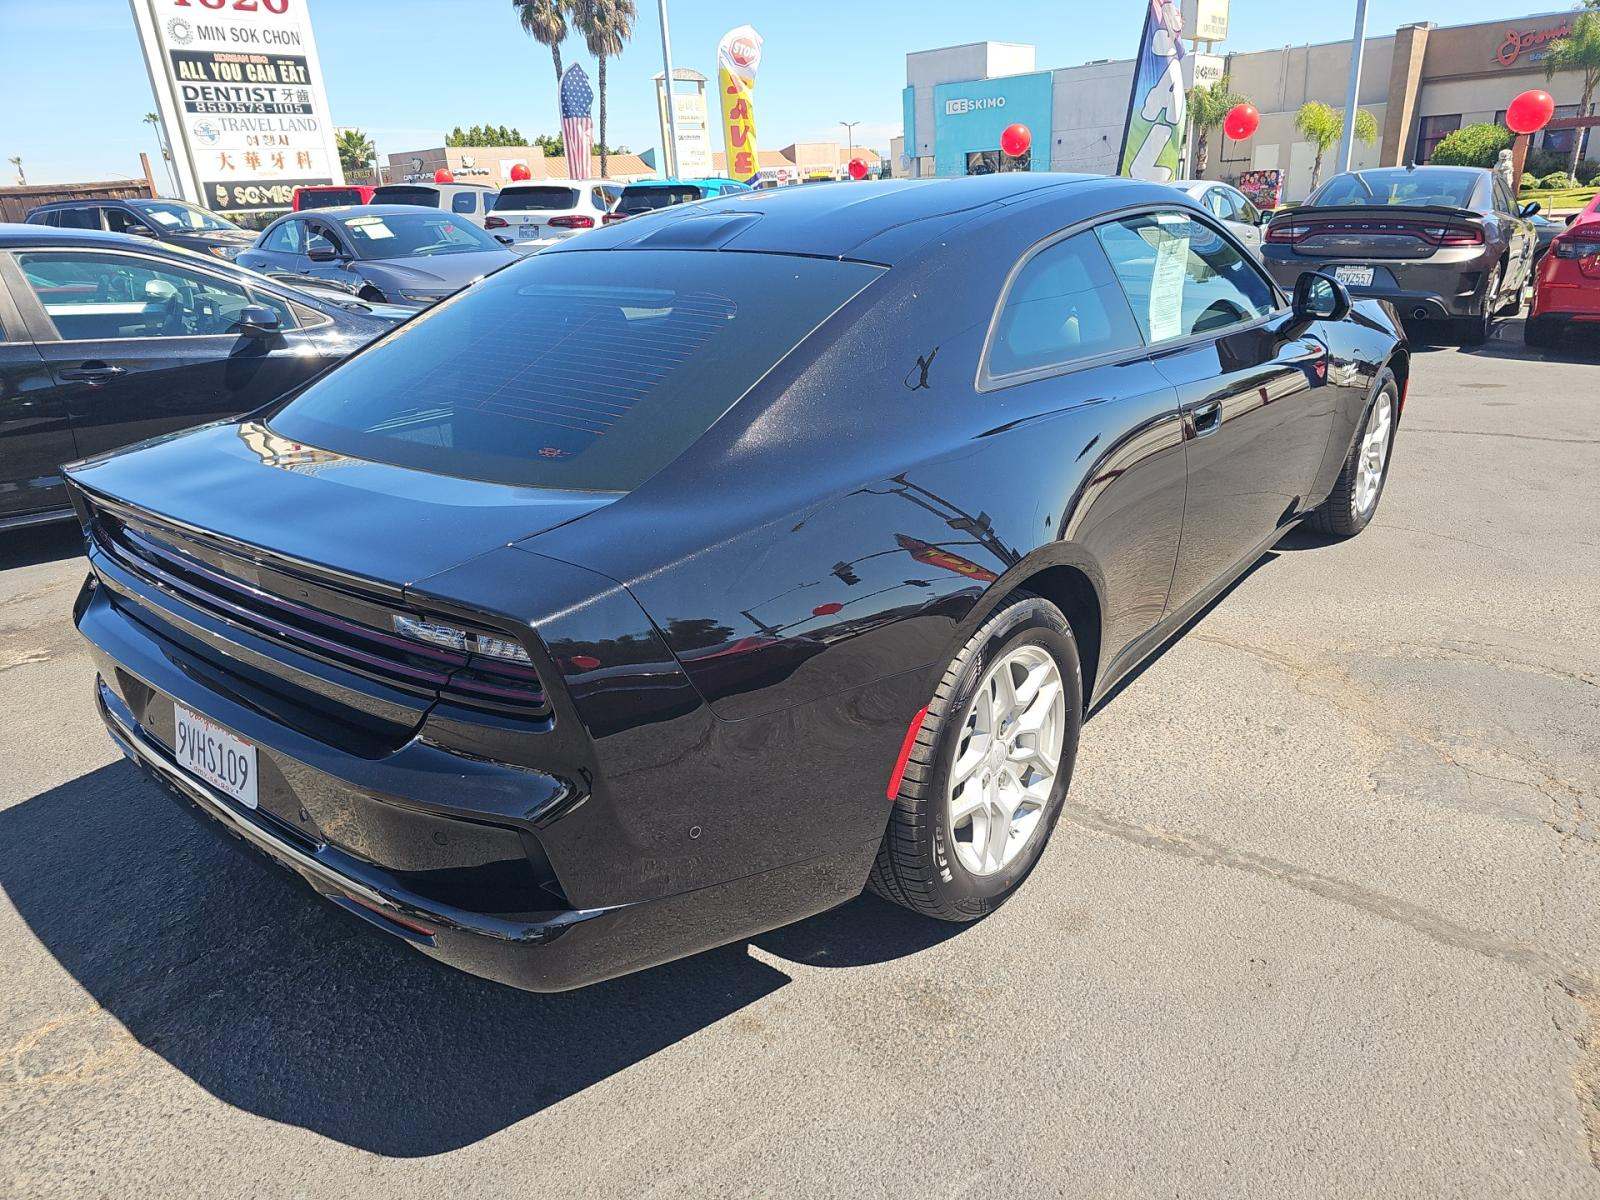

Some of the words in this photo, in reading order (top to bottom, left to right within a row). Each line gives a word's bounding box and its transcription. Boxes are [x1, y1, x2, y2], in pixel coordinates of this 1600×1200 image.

[197, 25, 226, 41] MIN
[230, 27, 260, 43] SOK
[263, 29, 301, 45] CHON
[179, 61, 207, 80] ALL
[210, 62, 242, 81] YOU
[246, 64, 277, 82] CAN
[280, 65, 306, 83] EAT
[182, 86, 276, 102] DENTIST
[946, 96, 1006, 115] ICESKIMO
[218, 117, 276, 132] TRAVEL
[280, 119, 317, 132] LAND
[178, 721, 248, 791] 9VHS109
